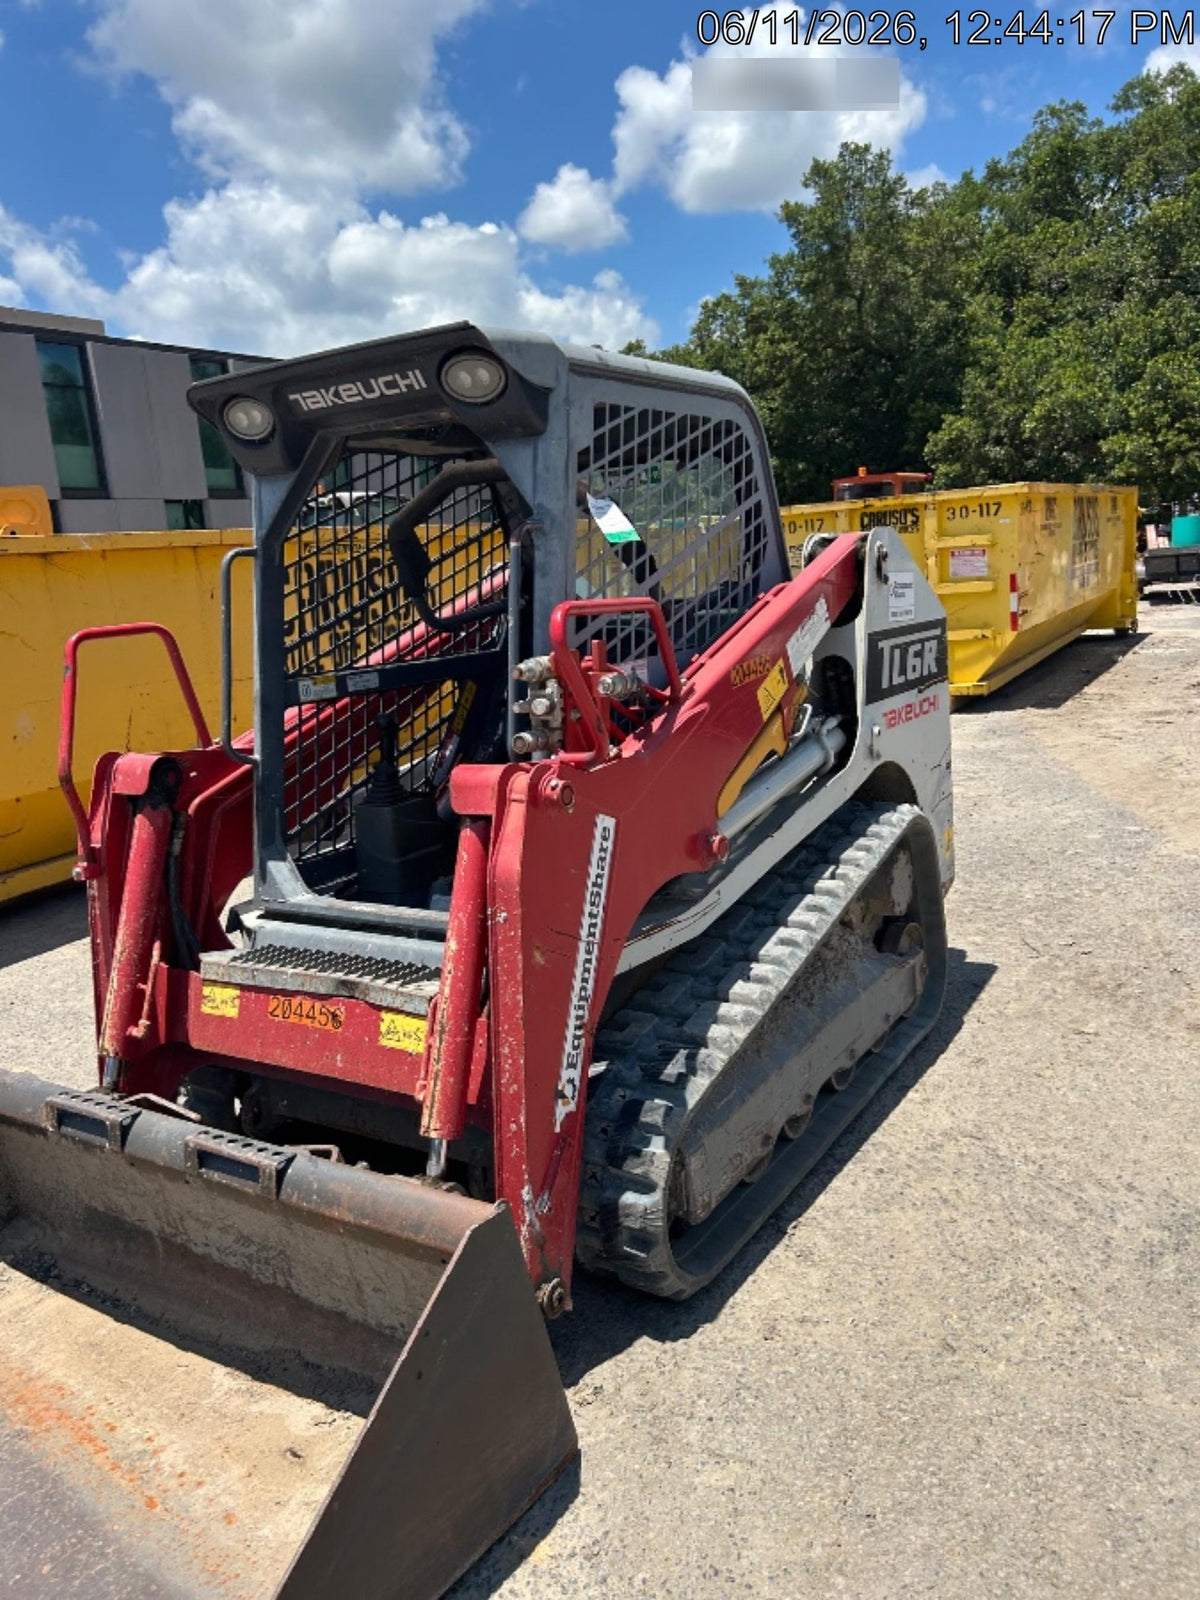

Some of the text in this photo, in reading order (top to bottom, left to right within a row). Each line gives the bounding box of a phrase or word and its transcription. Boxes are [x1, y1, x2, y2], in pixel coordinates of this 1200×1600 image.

[288, 369, 427, 411] TAKEUCHI
[878, 627, 941, 689] TL6R
[882, 693, 940, 730] TAKEUCHI
[565, 826, 611, 1071] EquipmentShare
